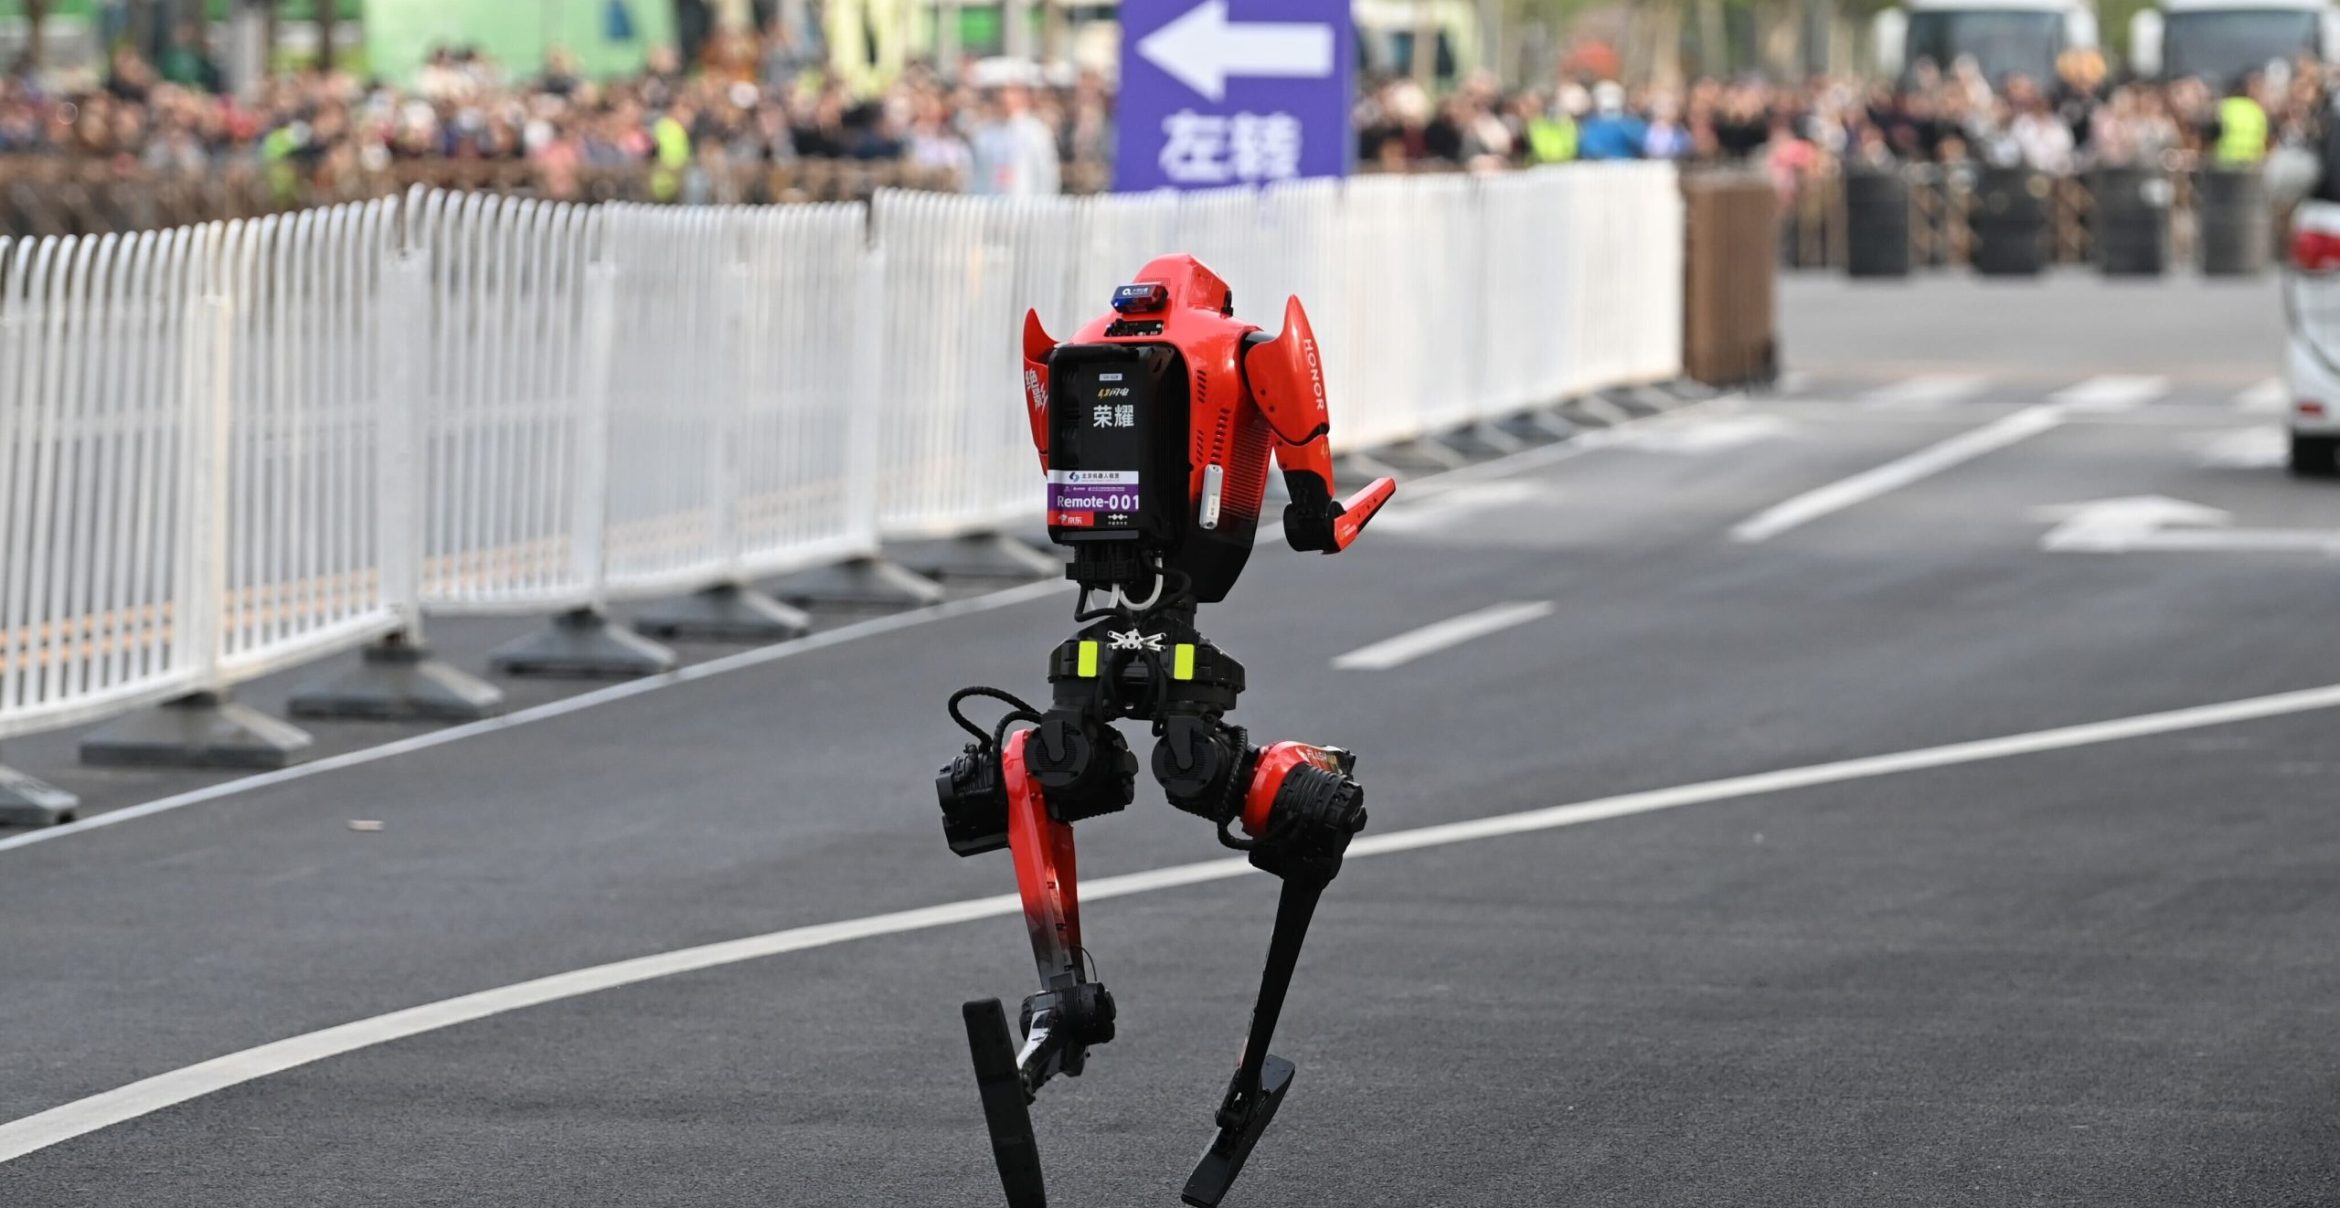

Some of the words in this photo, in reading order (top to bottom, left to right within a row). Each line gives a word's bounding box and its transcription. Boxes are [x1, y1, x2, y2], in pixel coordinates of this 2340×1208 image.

[1159, 109, 1301, 181] 左转
[1304, 338, 1325, 411] HONOR
[1093, 404, 1135, 428] 荣耀
[1057, 494, 1139, 510] Remote-001
